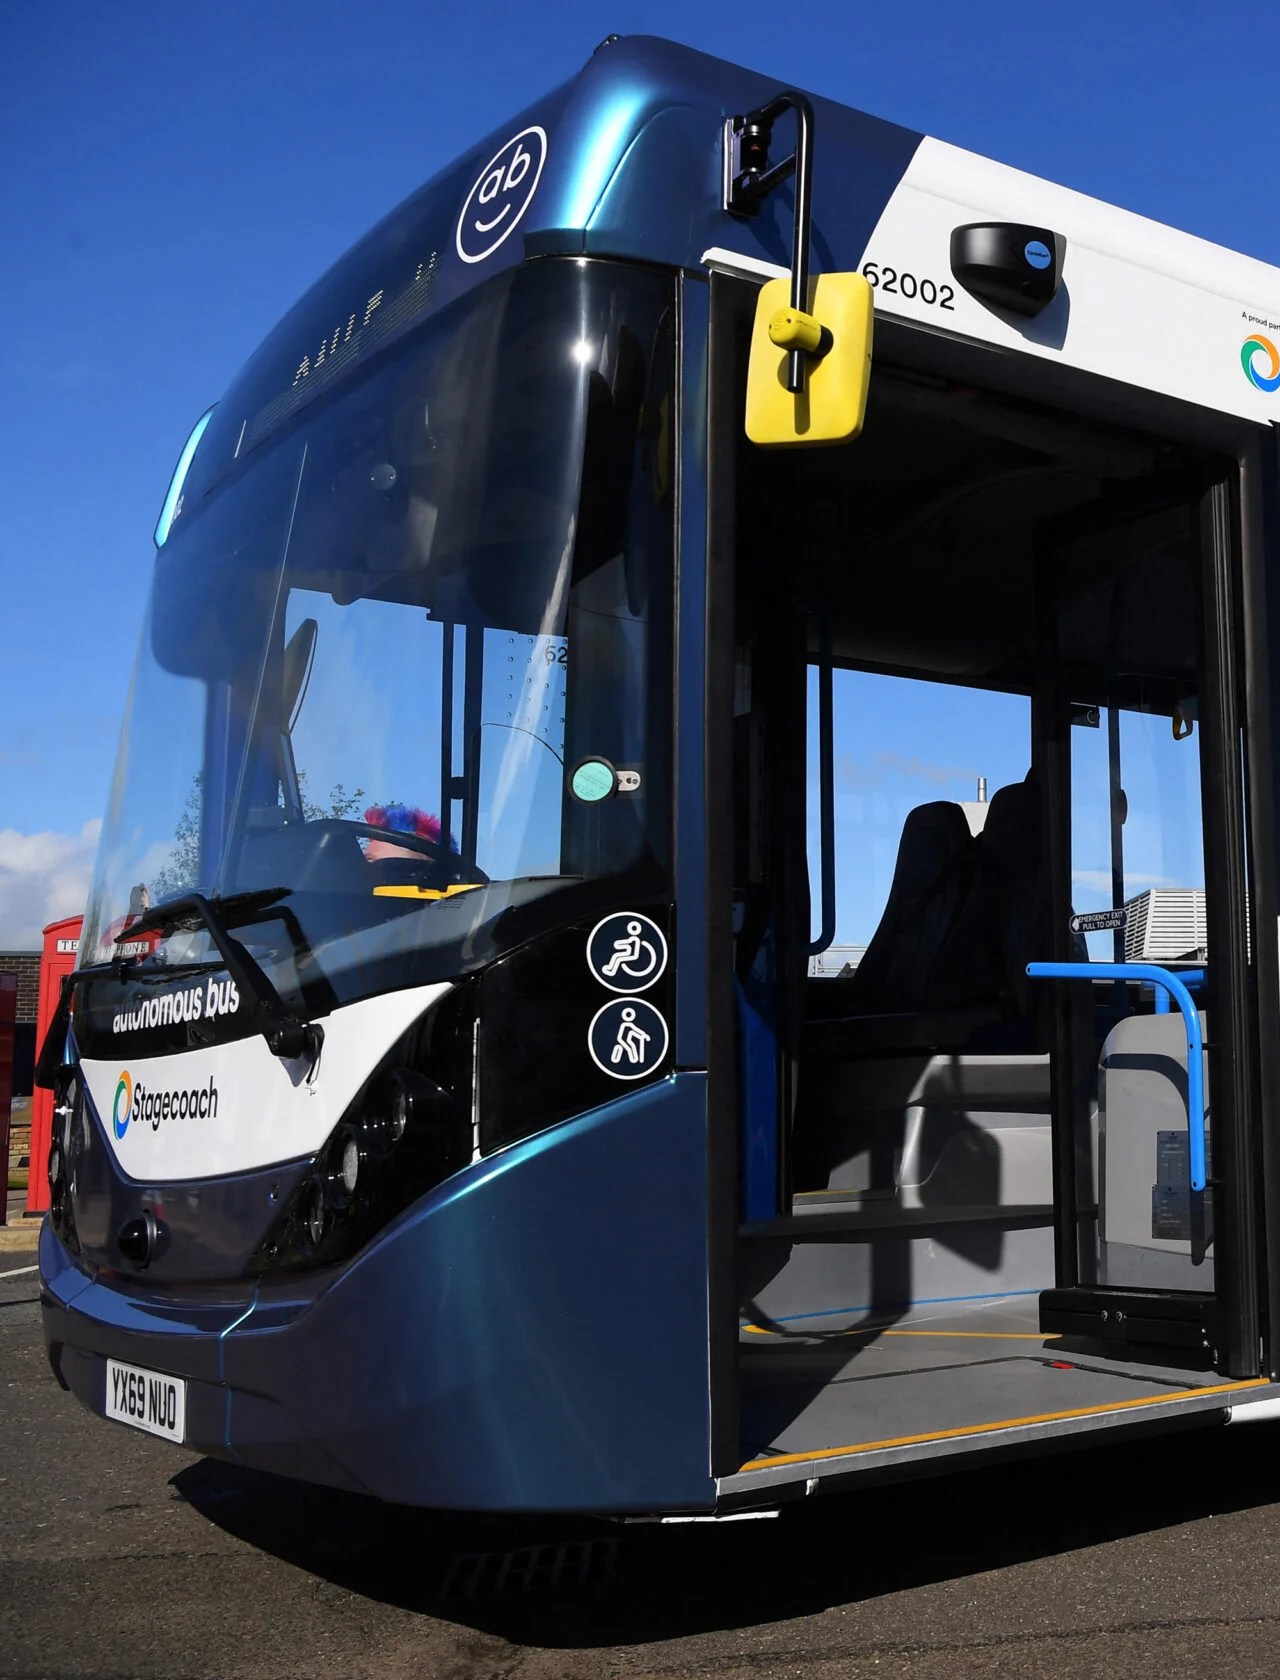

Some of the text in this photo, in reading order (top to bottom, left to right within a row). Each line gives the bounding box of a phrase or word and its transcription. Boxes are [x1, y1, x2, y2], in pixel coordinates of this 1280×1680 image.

[479, 144, 531, 205] ab
[862, 262, 955, 311] 62002
[1241, 311, 1248, 319] A
[1248, 314, 1268, 327] proud
[1079, 911, 1123, 924] EMERGENCY EXIT
[205, 978, 240, 1018] bus
[132, 1075, 218, 1131] Stagecoach
[112, 1367, 146, 1419] YX69
